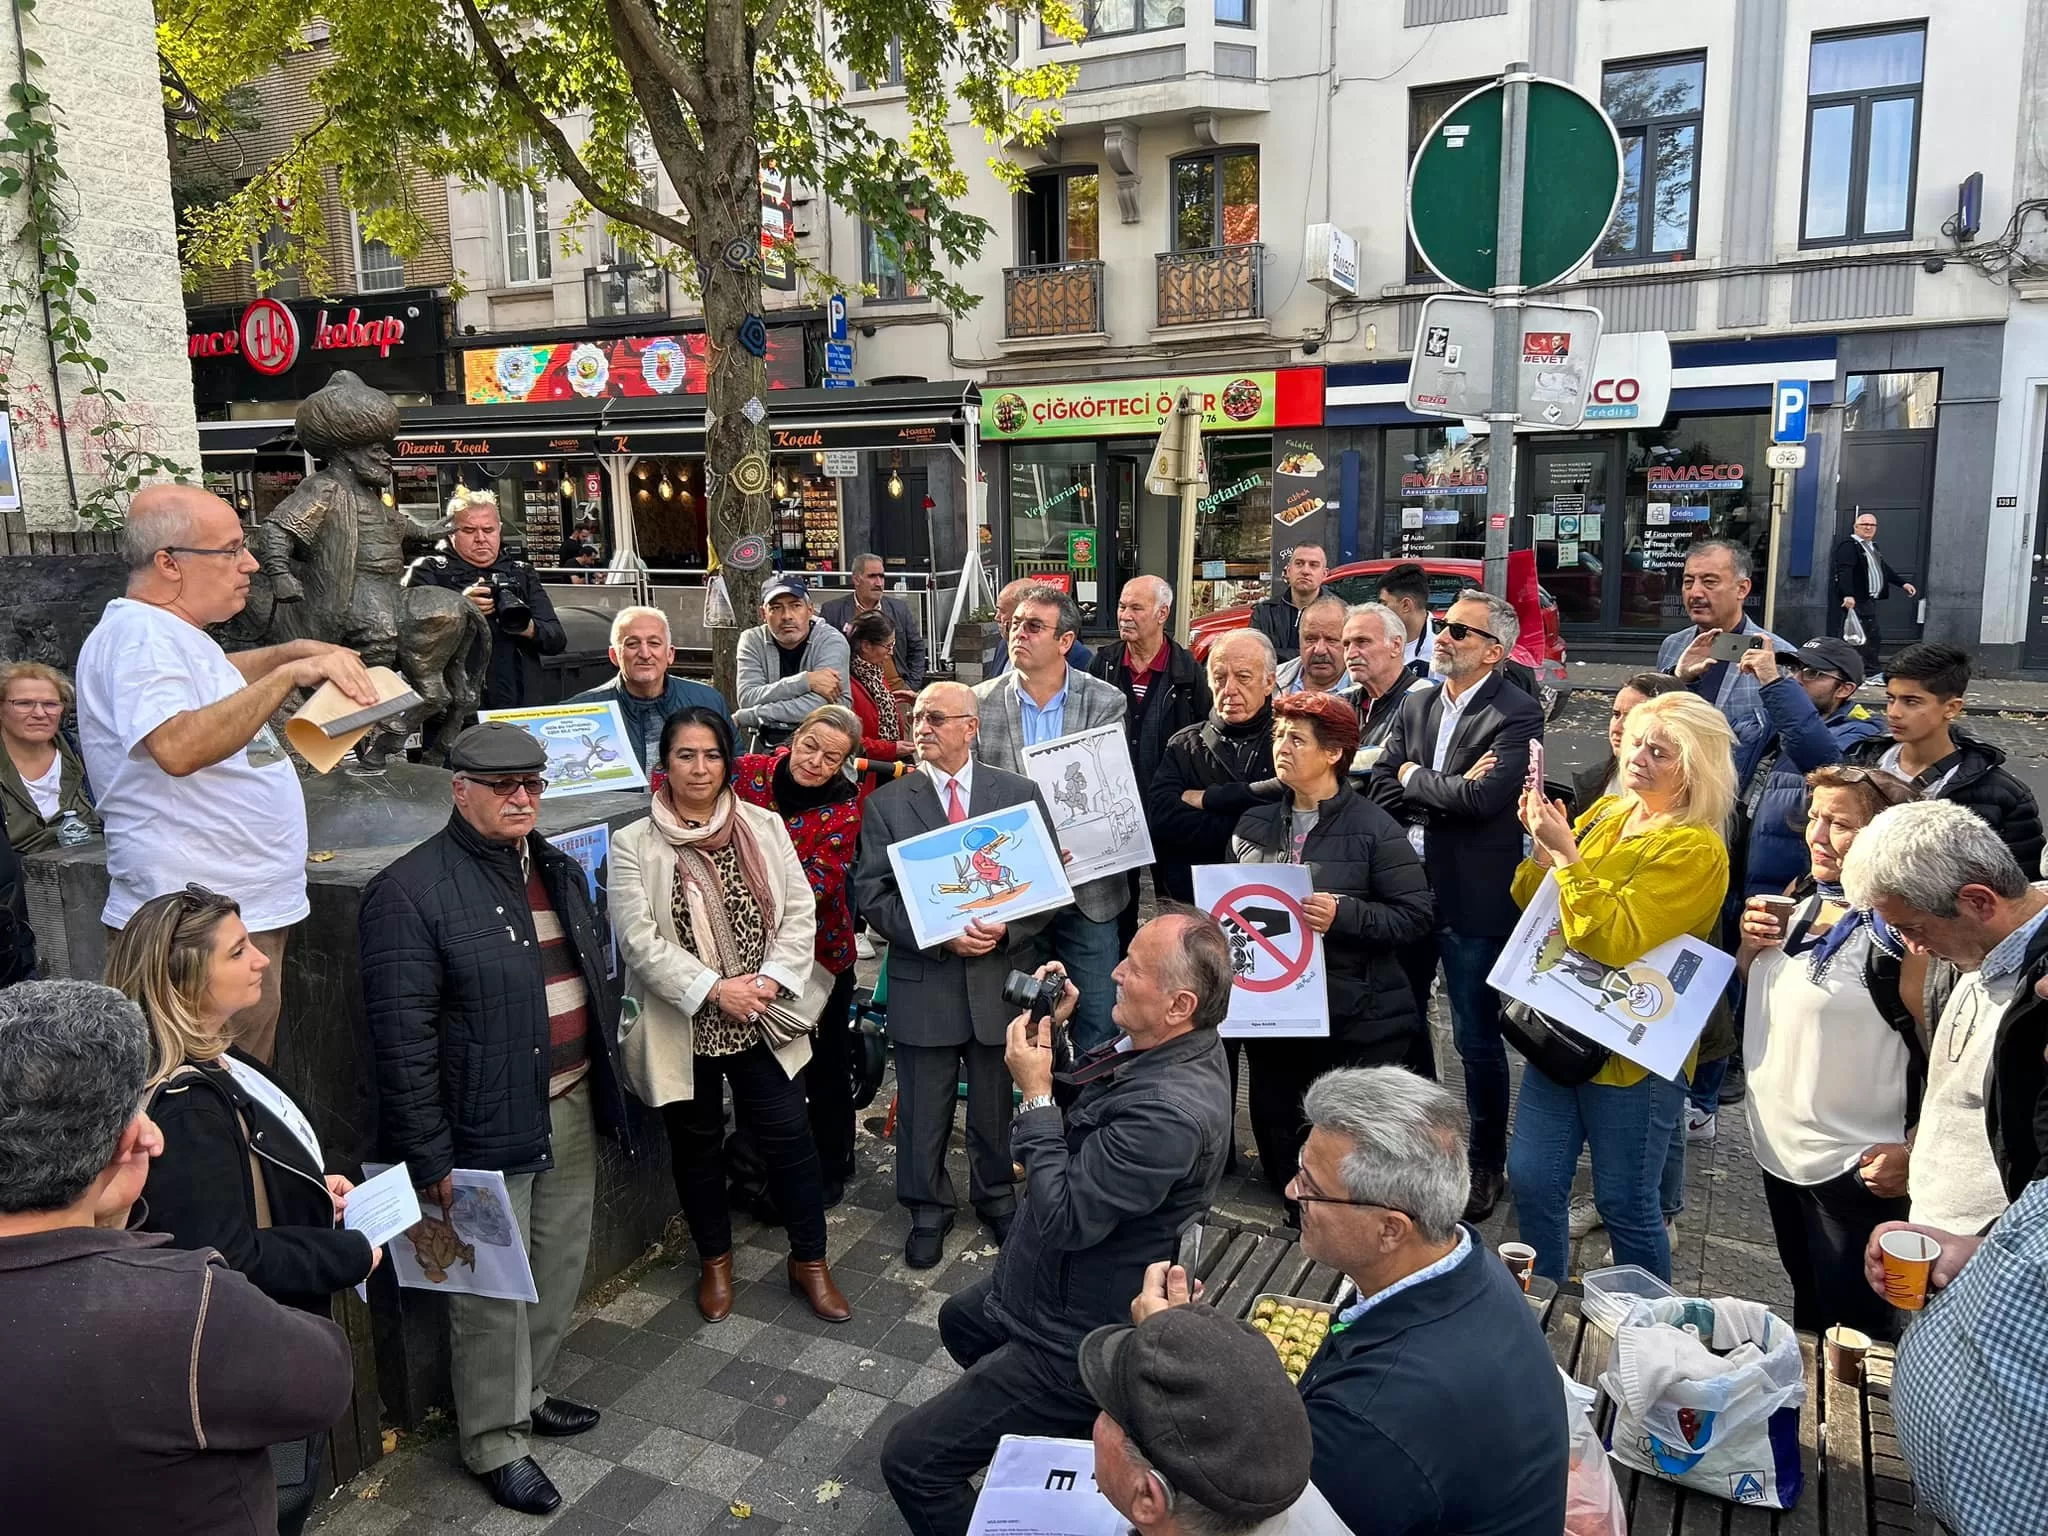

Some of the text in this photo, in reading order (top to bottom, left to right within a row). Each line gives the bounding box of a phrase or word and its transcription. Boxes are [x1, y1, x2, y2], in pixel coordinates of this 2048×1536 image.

[832, 300, 845, 333] P
[187, 329, 240, 358] nce
[311, 307, 405, 358] kebap
[1523, 355, 1566, 364] #EVET
[1588, 378, 1640, 404] CO
[1032, 391, 1216, 425] ÇİĞKÖFTECİ ÖR
[1778, 387, 1804, 432] P
[397, 440, 490, 457] Pizzeria Koçak
[773, 429, 823, 447] Koçak
[1648, 463, 1744, 481] FIMASCO
[1024, 482, 1083, 519] Vegetarian
[1198, 472, 1264, 514] egetarian
[1672, 508, 1695, 518] Crédits
[1410, 543, 1435, 551] Incendie
[1652, 531, 1693, 539] Financement
